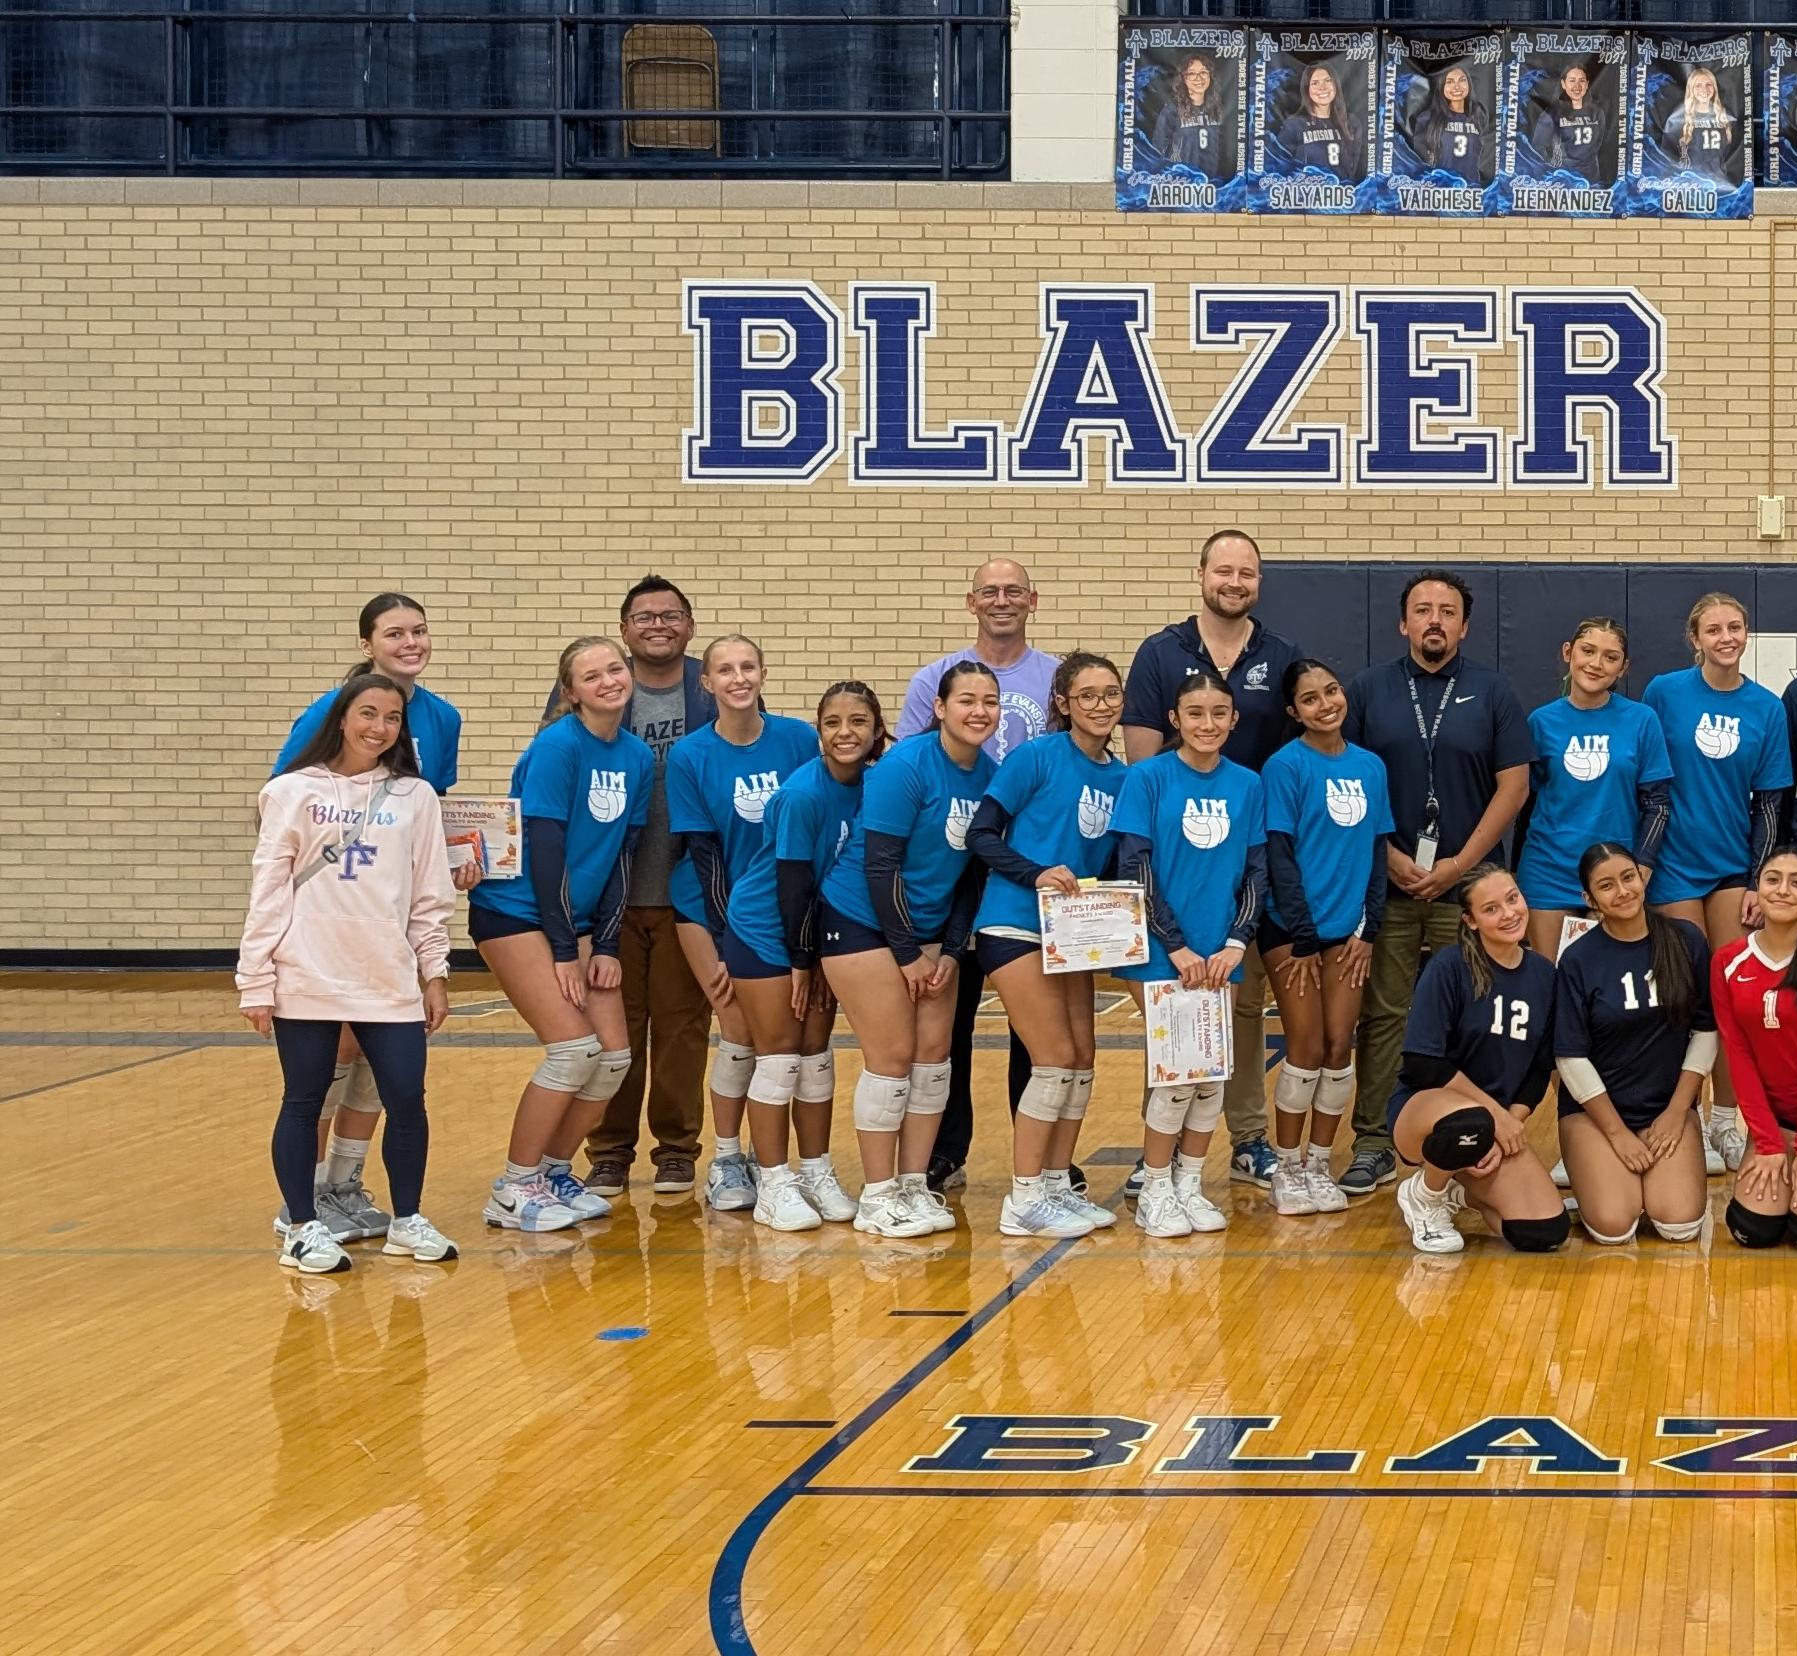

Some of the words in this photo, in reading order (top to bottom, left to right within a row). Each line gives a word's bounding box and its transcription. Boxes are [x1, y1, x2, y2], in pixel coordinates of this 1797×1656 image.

[1150, 29, 1244, 48] BLAZERS
[1281, 33, 1374, 50] BLAZERS
[1411, 35, 1501, 60] BLAZERS
[1536, 34, 1625, 54] BLAZERS
[1661, 37, 1748, 62] BLAZERS
[1238, 58, 1247, 87] SCHOOL
[1368, 59, 1376, 89] SCHOOL
[1619, 63, 1627, 93] SCHOOL
[1744, 64, 1752, 94] SCHOOL
[1123, 59, 1135, 135] VOLLEYBALL
[1238, 90, 1246, 110] HIGH
[1254, 61, 1266, 137] VOLLEYBALL
[1368, 91, 1376, 111] HIGH
[1383, 63, 1397, 139] VOLLEYBALL
[1506, 63, 1520, 138] VOLLEYBALL
[1619, 96, 1627, 115] HIGH
[1633, 64, 1647, 140] VOLLEYBALL
[1744, 96, 1752, 116] HIGH
[1769, 67, 1780, 144] VOLLEYBALL
[1198, 128, 1209, 149] 6
[1237, 112, 1246, 140] TRAIL
[1368, 113, 1376, 140] TRAIL
[1574, 127, 1593, 145] 13
[1618, 118, 1626, 145] TRAIL
[1744, 117, 1752, 145] TRAIL
[1454, 135, 1468, 157] 3
[1702, 130, 1721, 150] 12
[1123, 138, 1133, 170] GIRLS
[1253, 139, 1264, 173] GIRLS
[1327, 143, 1340, 166] 8
[1382, 141, 1393, 174] GIRLS
[1505, 141, 1516, 174] GIRLS
[1632, 142, 1643, 175] GIRLS
[1769, 147, 1780, 180] GIRLS
[1147, 184, 1217, 208] ARROYO
[1270, 186, 1356, 209] SALYARDS
[1399, 188, 1484, 212] VARGHESE
[1513, 188, 1613, 213] HERNANDEZ
[1663, 190, 1718, 213] GALLO
[682, 282, 1678, 489] BLAZER
[1697, 712, 1741, 735] AIM
[1566, 735, 1610, 752] AIM
[590, 769, 626, 791] AIM
[734, 771, 780, 796] AIM
[1326, 778, 1365, 797] AIM
[1079, 785, 1115, 813] AIM
[1183, 798, 1229, 817] AIM
[306, 803, 398, 826] Blazrs
[442, 811, 496, 820] TSTANDING
[1061, 902, 1122, 913] OUTSTANDING
[1620, 969, 1660, 1010] 11
[1490, 994, 1530, 1041] 12
[1762, 989, 1781, 1029] 1
[1202, 999, 1212, 1059] OUTSTANDING
